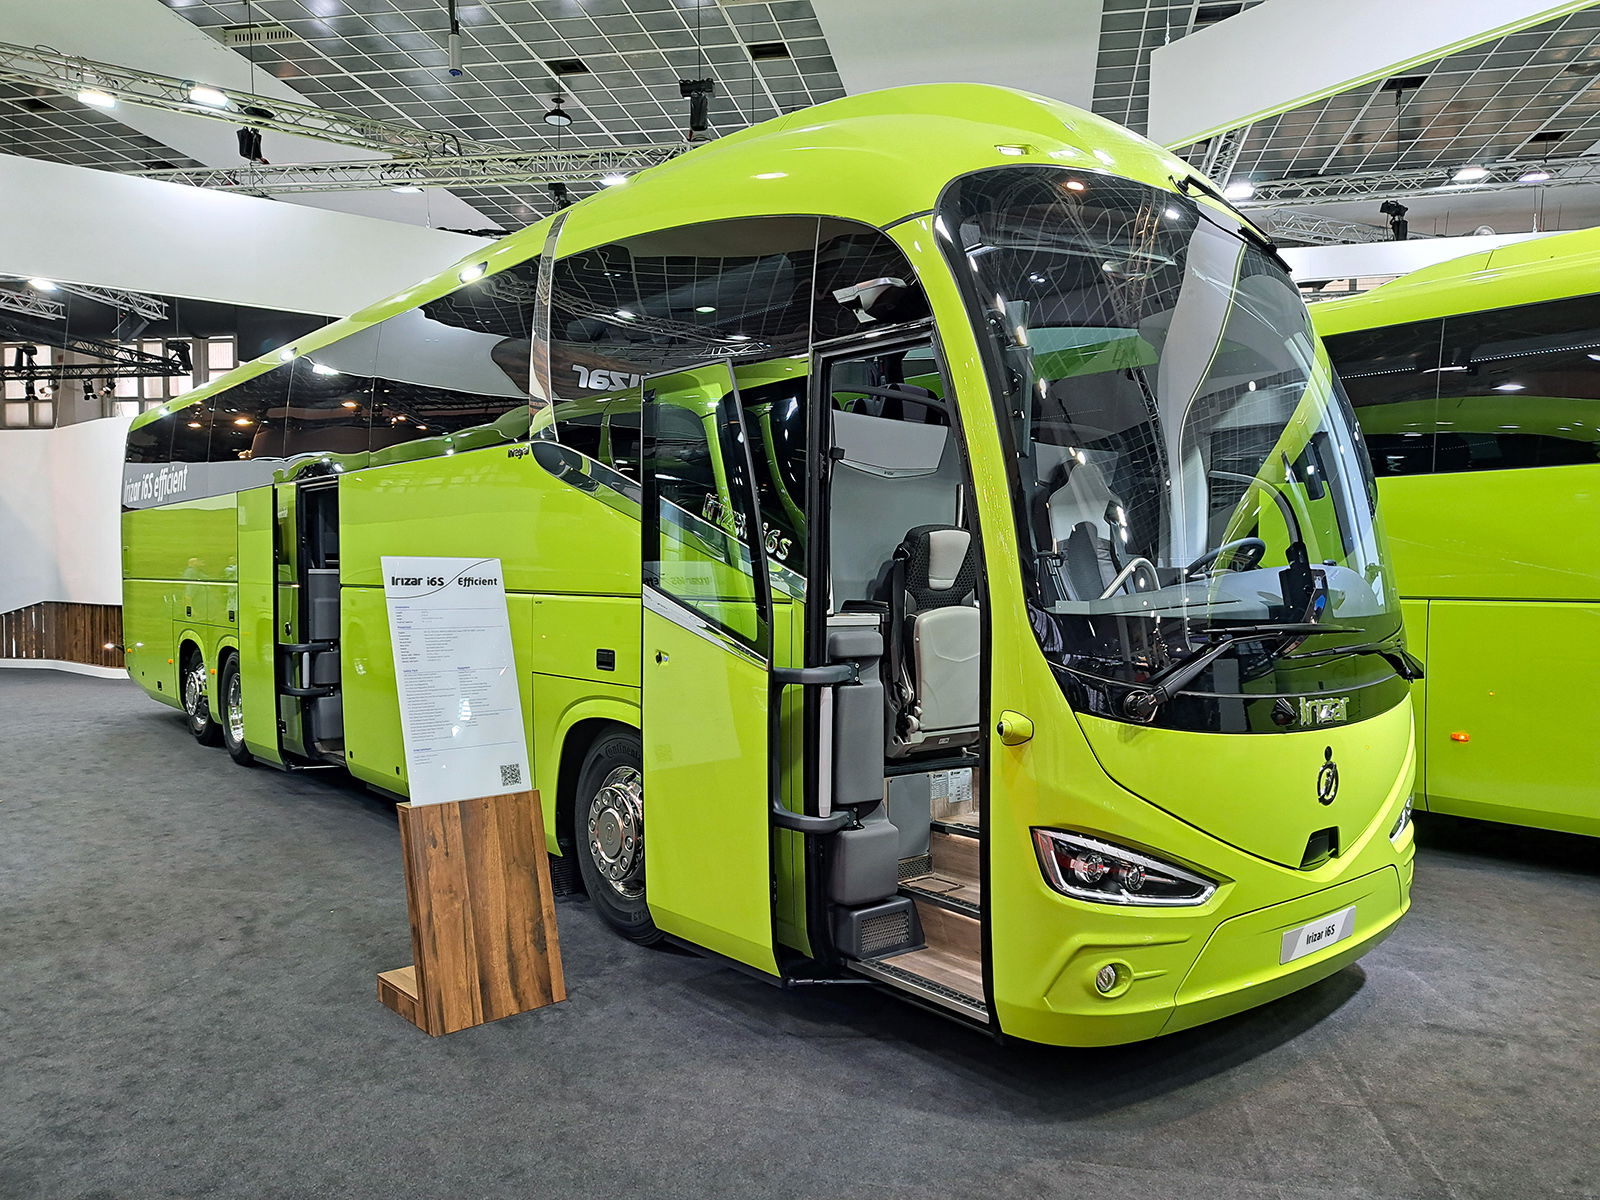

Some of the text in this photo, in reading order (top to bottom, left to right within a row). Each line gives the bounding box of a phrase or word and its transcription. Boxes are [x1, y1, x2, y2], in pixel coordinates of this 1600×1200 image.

[124, 464, 188, 503] Irizar i6S efficient
[426, 576, 445, 587] i6S
[457, 576, 498, 588] Efficient
[1306, 923, 1336, 945] Irizar i6S
